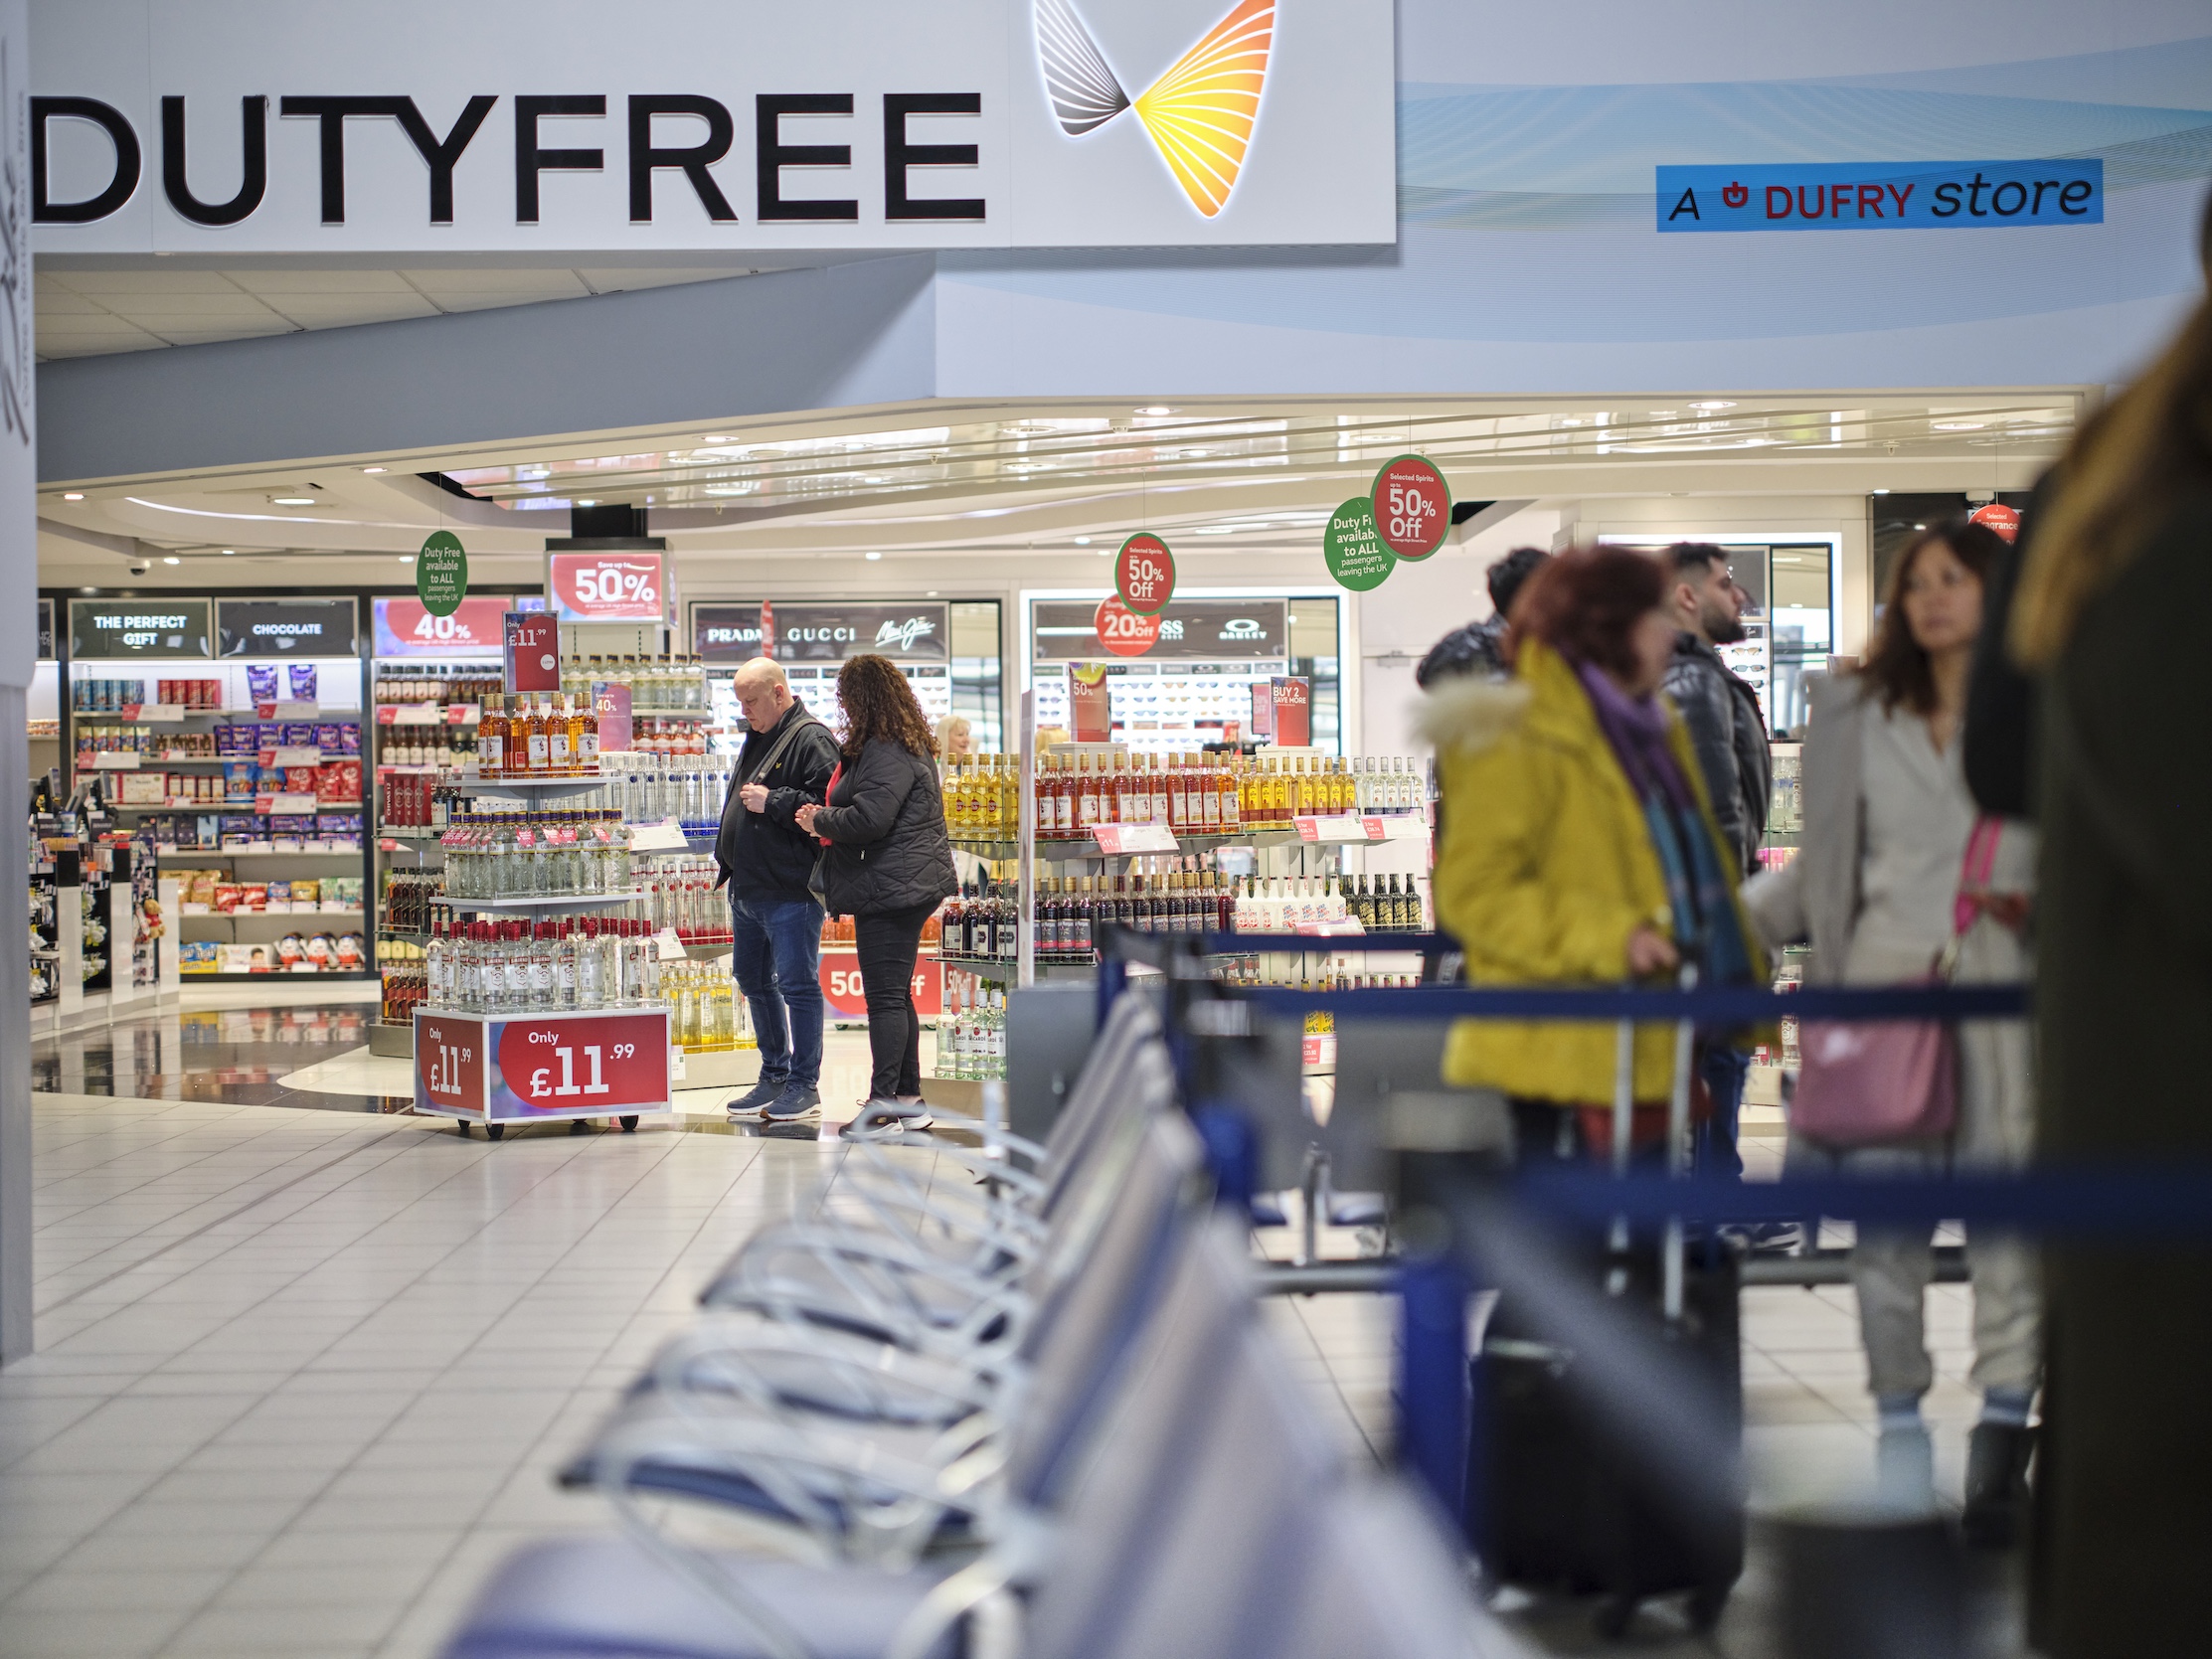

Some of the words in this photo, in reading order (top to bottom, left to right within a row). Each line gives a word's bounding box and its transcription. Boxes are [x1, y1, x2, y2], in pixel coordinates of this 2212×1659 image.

[30, 92, 986, 227] DUTYFREE
[1669, 187, 1700, 221] A
[1766, 183, 1915, 220] DUFRY
[1931, 173, 2093, 218] store
[1390, 488, 1437, 517] 50%
[1333, 518, 1360, 530] Duty
[1390, 517, 1423, 538] Off
[1976, 521, 2019, 532] ragrance
[1336, 529, 1378, 544] availab
[425, 547, 443, 560] Duty
[444, 547, 460, 558] Free
[1344, 548, 1356, 557] to
[1358, 543, 1379, 555] ALL
[425, 560, 458, 571] available
[1341, 555, 1383, 568] passengers
[1129, 559, 1164, 581] 50%
[1337, 567, 1362, 577] leaving
[430, 575, 438, 583] to
[439, 574, 454, 583] ALL
[575, 568, 656, 603] 50%
[1129, 581, 1154, 598] Off
[93, 616, 121, 628] THE
[124, 615, 187, 628] PERFECT
[414, 613, 472, 639] 40%
[253, 624, 322, 635] CHOCOLATE
[787, 627, 855, 642] GUCCI
[123, 632, 158, 645] GIFT
[1074, 683, 1094, 696] 50%
[1274, 687, 1291, 697] BUY
[1294, 687, 1299, 697] 2
[596, 700, 616, 712] 40%
[831, 971, 864, 996] 50
[429, 1028, 442, 1042] Only
[528, 1032, 559, 1045] Only
[430, 1045, 472, 1095] £11.99
[530, 1044, 635, 1097] £11.99
